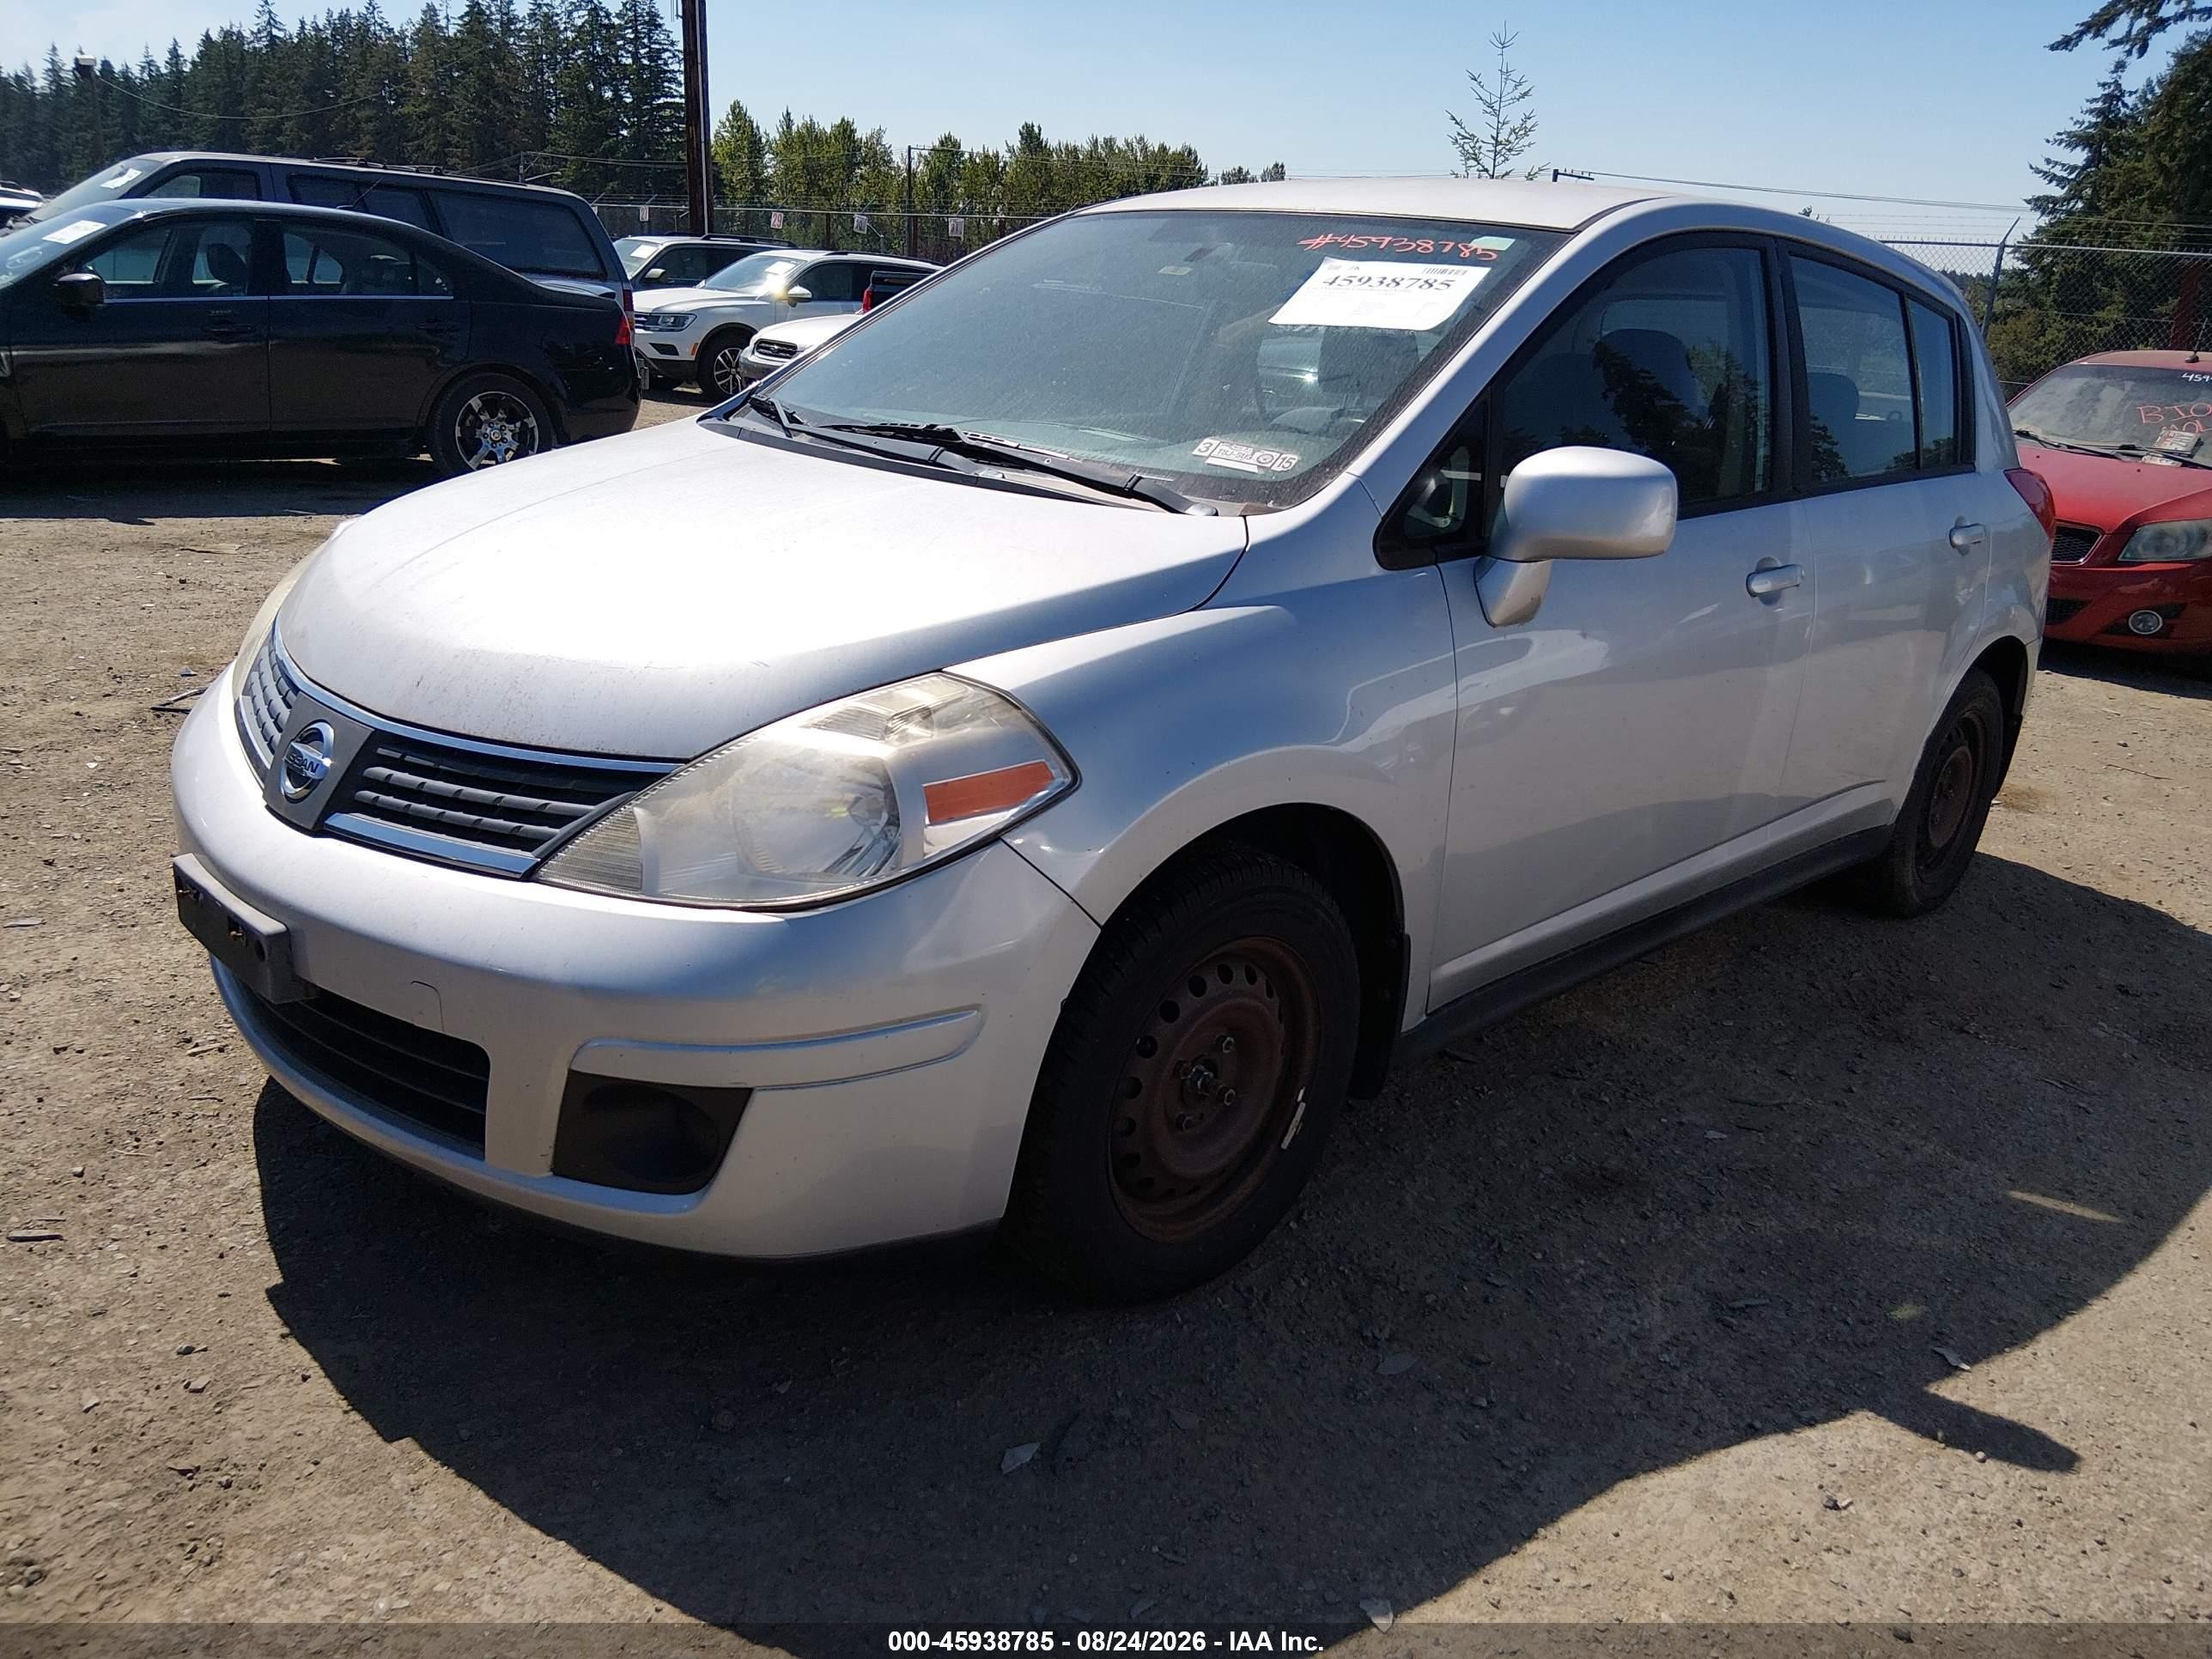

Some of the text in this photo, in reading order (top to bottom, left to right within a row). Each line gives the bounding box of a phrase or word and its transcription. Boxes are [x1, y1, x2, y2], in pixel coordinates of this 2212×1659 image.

[771, 212, 782, 228] 29
[1297, 233, 1498, 261] #45938785
[1322, 274, 1457, 290] 45938785
[2181, 372, 2212, 383] 459
[1199, 441, 1213, 453] 3
[1277, 455, 1297, 470] 15
